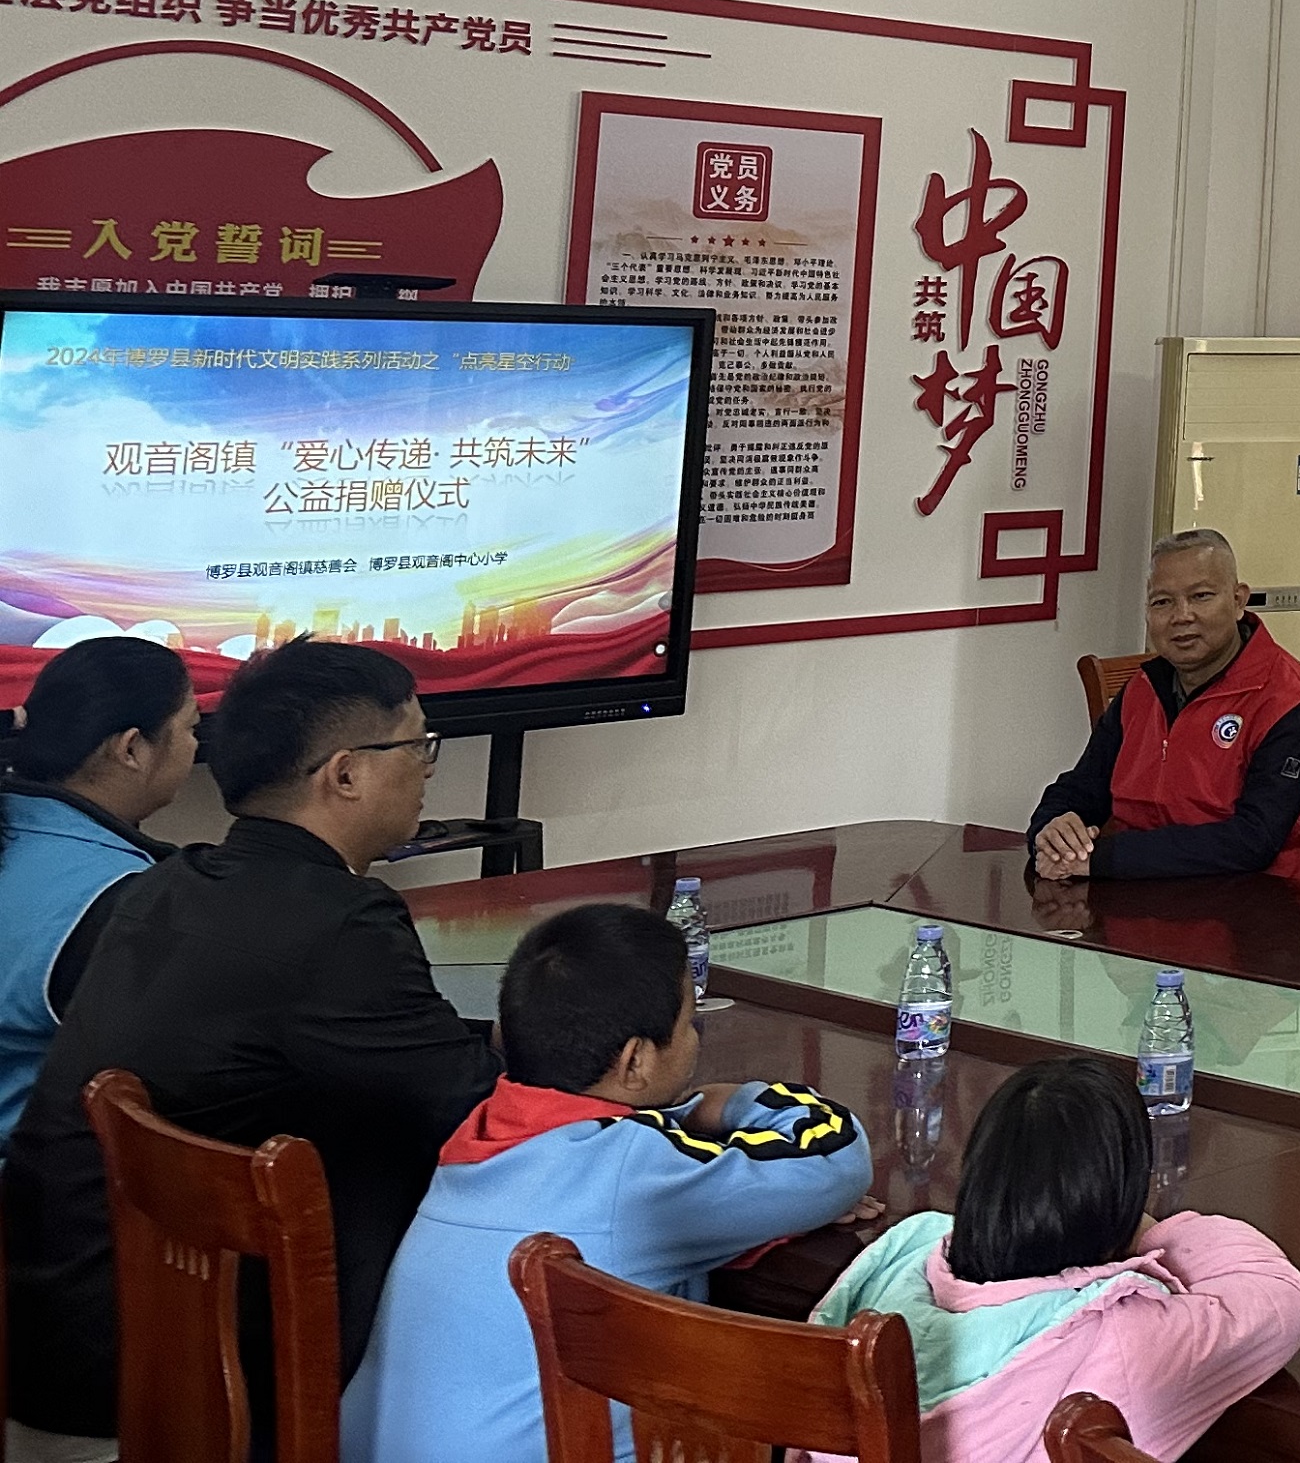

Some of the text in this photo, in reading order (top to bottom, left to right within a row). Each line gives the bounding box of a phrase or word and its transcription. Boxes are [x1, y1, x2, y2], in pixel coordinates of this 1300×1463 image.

[709, 152, 759, 181] 党员
[706, 184, 758, 212] 义务
[83, 219, 325, 266] 入党誓词
[913, 276, 947, 342] 共筑
[1033, 358, 1049, 434] GONGZHU
[1012, 358, 1032, 489] ZHONGGUOMENG
[262, 476, 471, 515] 公益捐赠仪式
